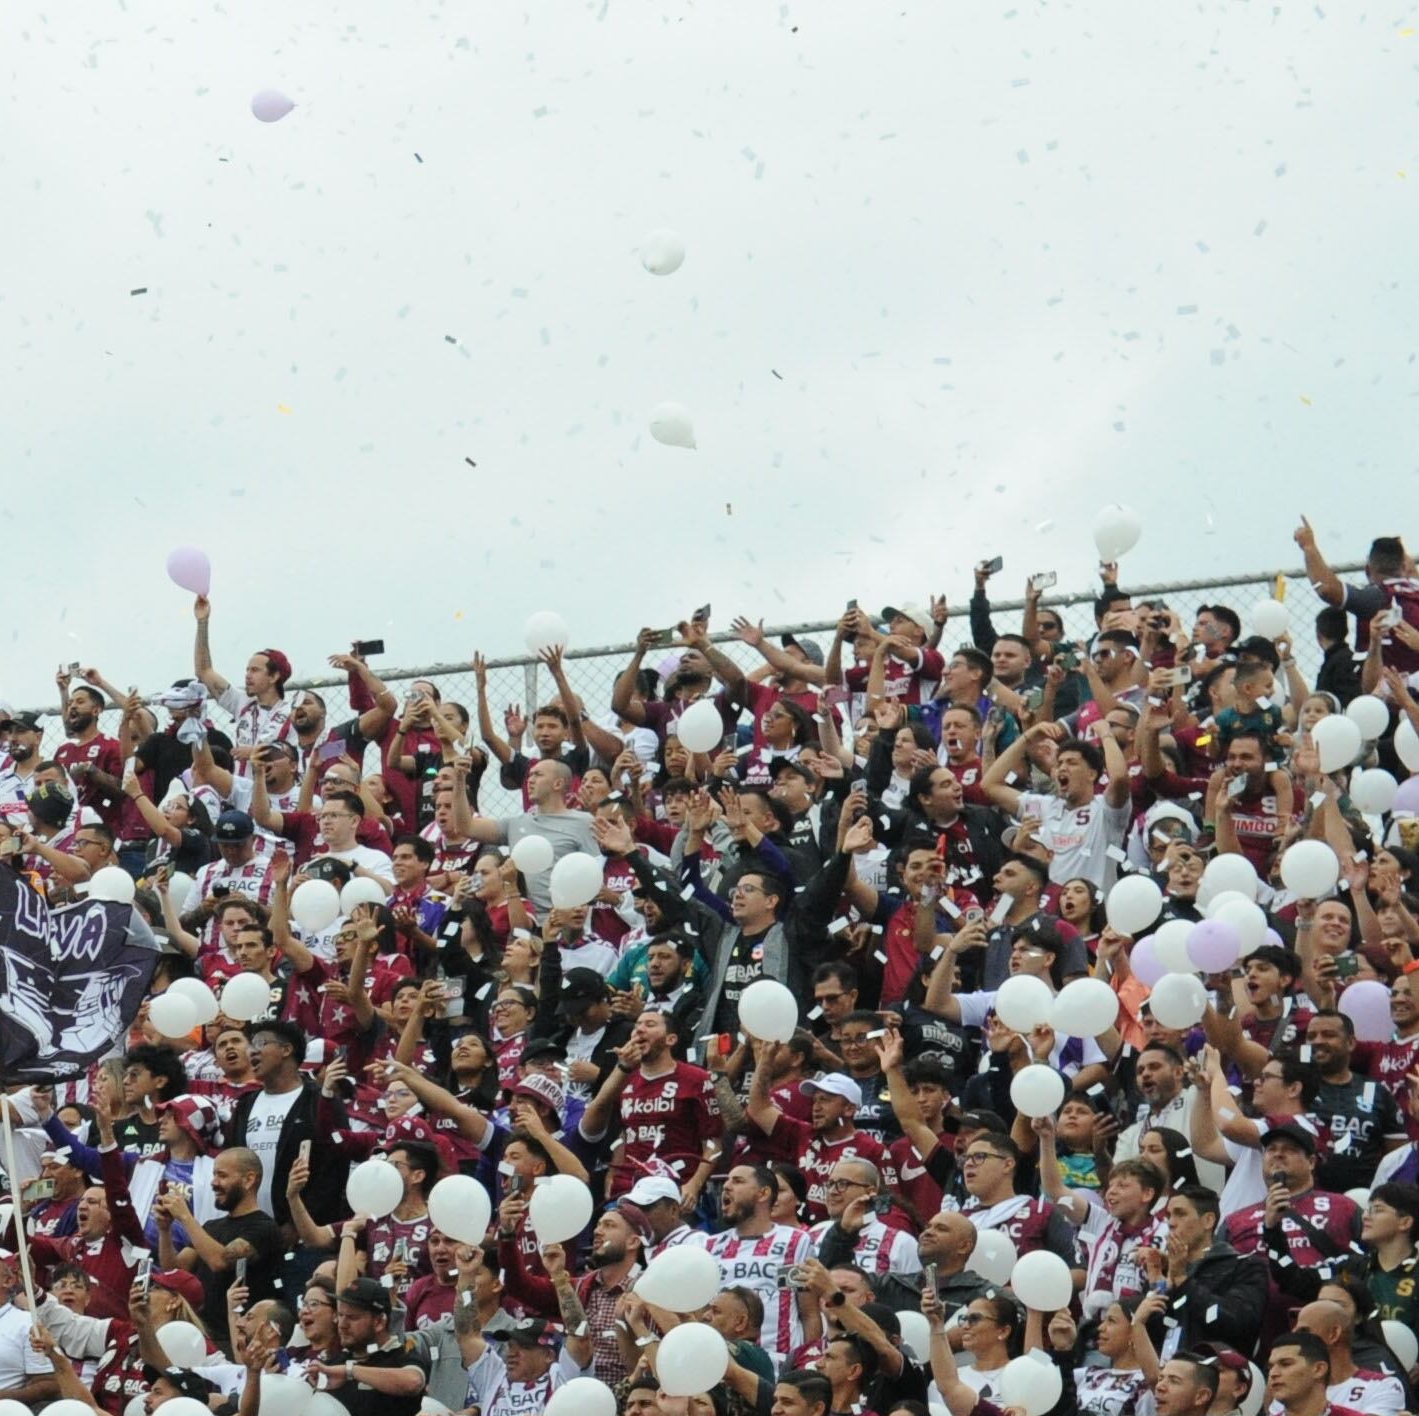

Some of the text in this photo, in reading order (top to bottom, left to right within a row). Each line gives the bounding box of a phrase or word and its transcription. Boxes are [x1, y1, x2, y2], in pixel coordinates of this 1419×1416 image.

[89, 746, 99, 758] S
[962, 769, 977, 785] S
[1261, 796, 1276, 814] S
[1076, 810, 1089, 825] S
[229, 880, 257, 892] BAC
[269, 988, 282, 1003] S
[662, 1082, 678, 1098] S
[635, 1096, 675, 1112] kölbi
[858, 1105, 881, 1118] AC
[266, 1114, 283, 1126] BA
[1331, 1115, 1373, 1136] BAC
[808, 1183, 824, 1199] BA
[1315, 1197, 1331, 1211] S
[999, 1224, 1023, 1238] AC
[1283, 1215, 1327, 1232] BC
[412, 1225, 428, 1241] S
[771, 1242, 786, 1254] S
[867, 1237, 879, 1251] S
[733, 1262, 775, 1280] BAC
[1397, 1279, 1415, 1296] S
[124, 1380, 149, 1393] BAC
[511, 1392, 546, 1408] BAC
[1350, 1387, 1365, 1402] S
